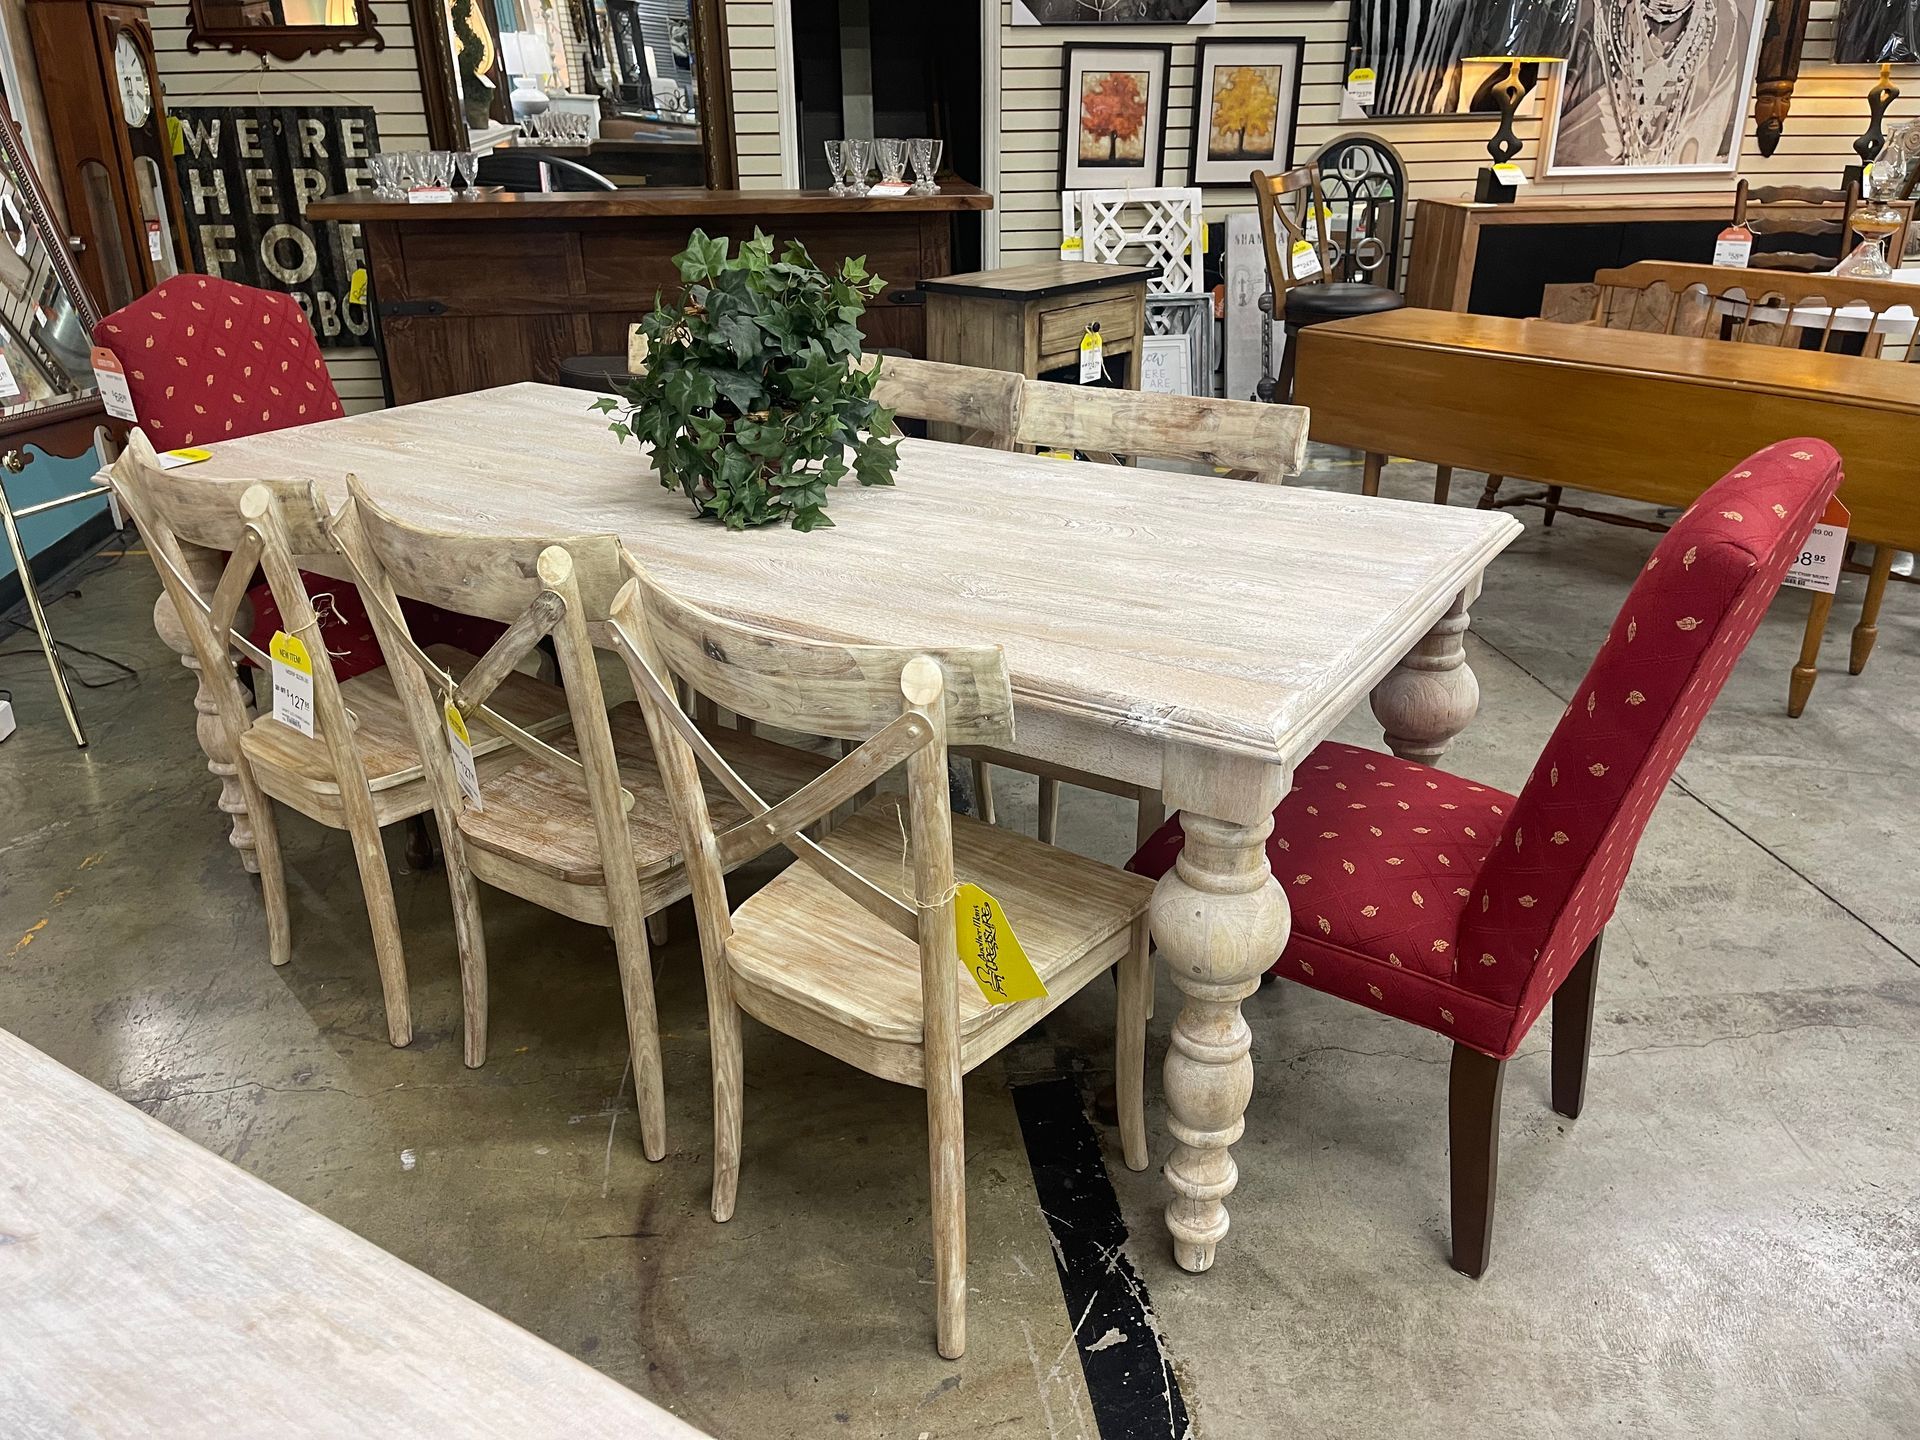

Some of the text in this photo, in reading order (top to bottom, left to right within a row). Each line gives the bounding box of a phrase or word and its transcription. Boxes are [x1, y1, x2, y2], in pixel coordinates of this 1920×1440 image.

[181, 118, 370, 159] WE'RE
[1145, 369, 1166, 379] ERE
[1812, 528, 1833, 537] 89.00
